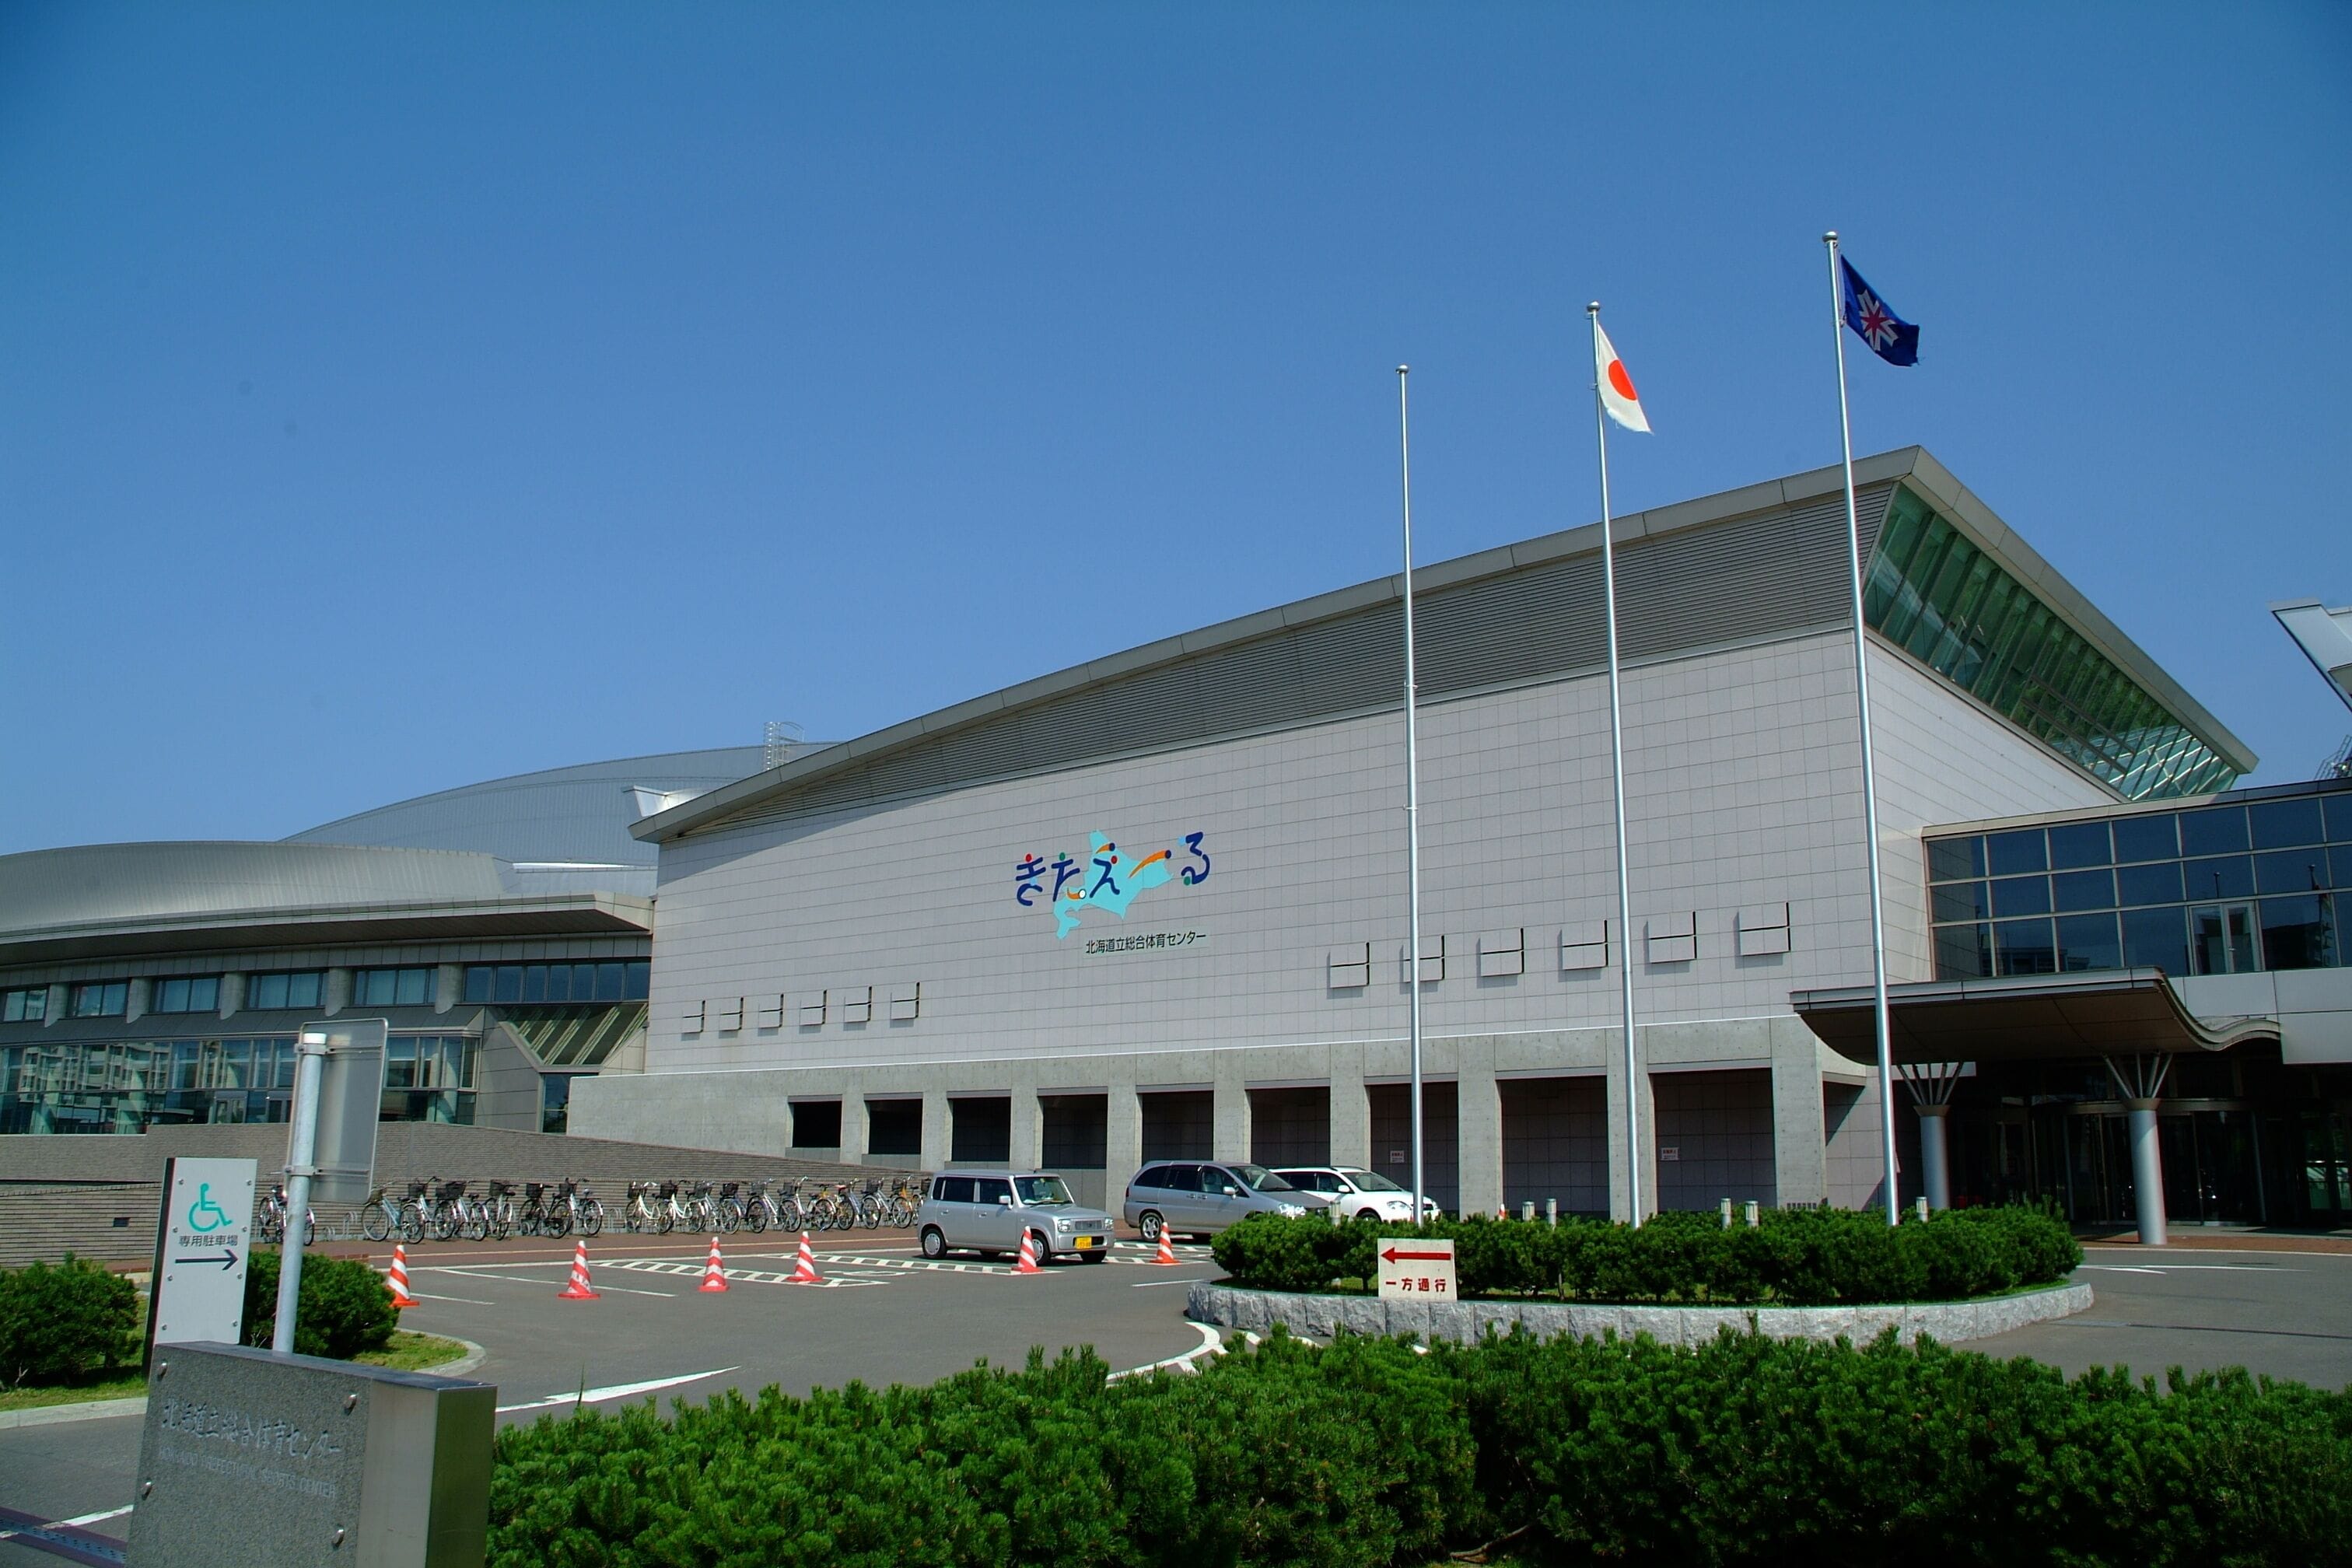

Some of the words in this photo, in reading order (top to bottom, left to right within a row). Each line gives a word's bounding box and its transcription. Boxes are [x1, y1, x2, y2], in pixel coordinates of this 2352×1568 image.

[1016, 831, 1210, 906] きたえーる
[1086, 930, 1206, 954] 北海道立総合体育センター
[179, 1234, 239, 1248] 専用駐車場
[1385, 1277, 1447, 1293] 一方通行
[161, 1398, 341, 1460] 北海道立総合体育センター
